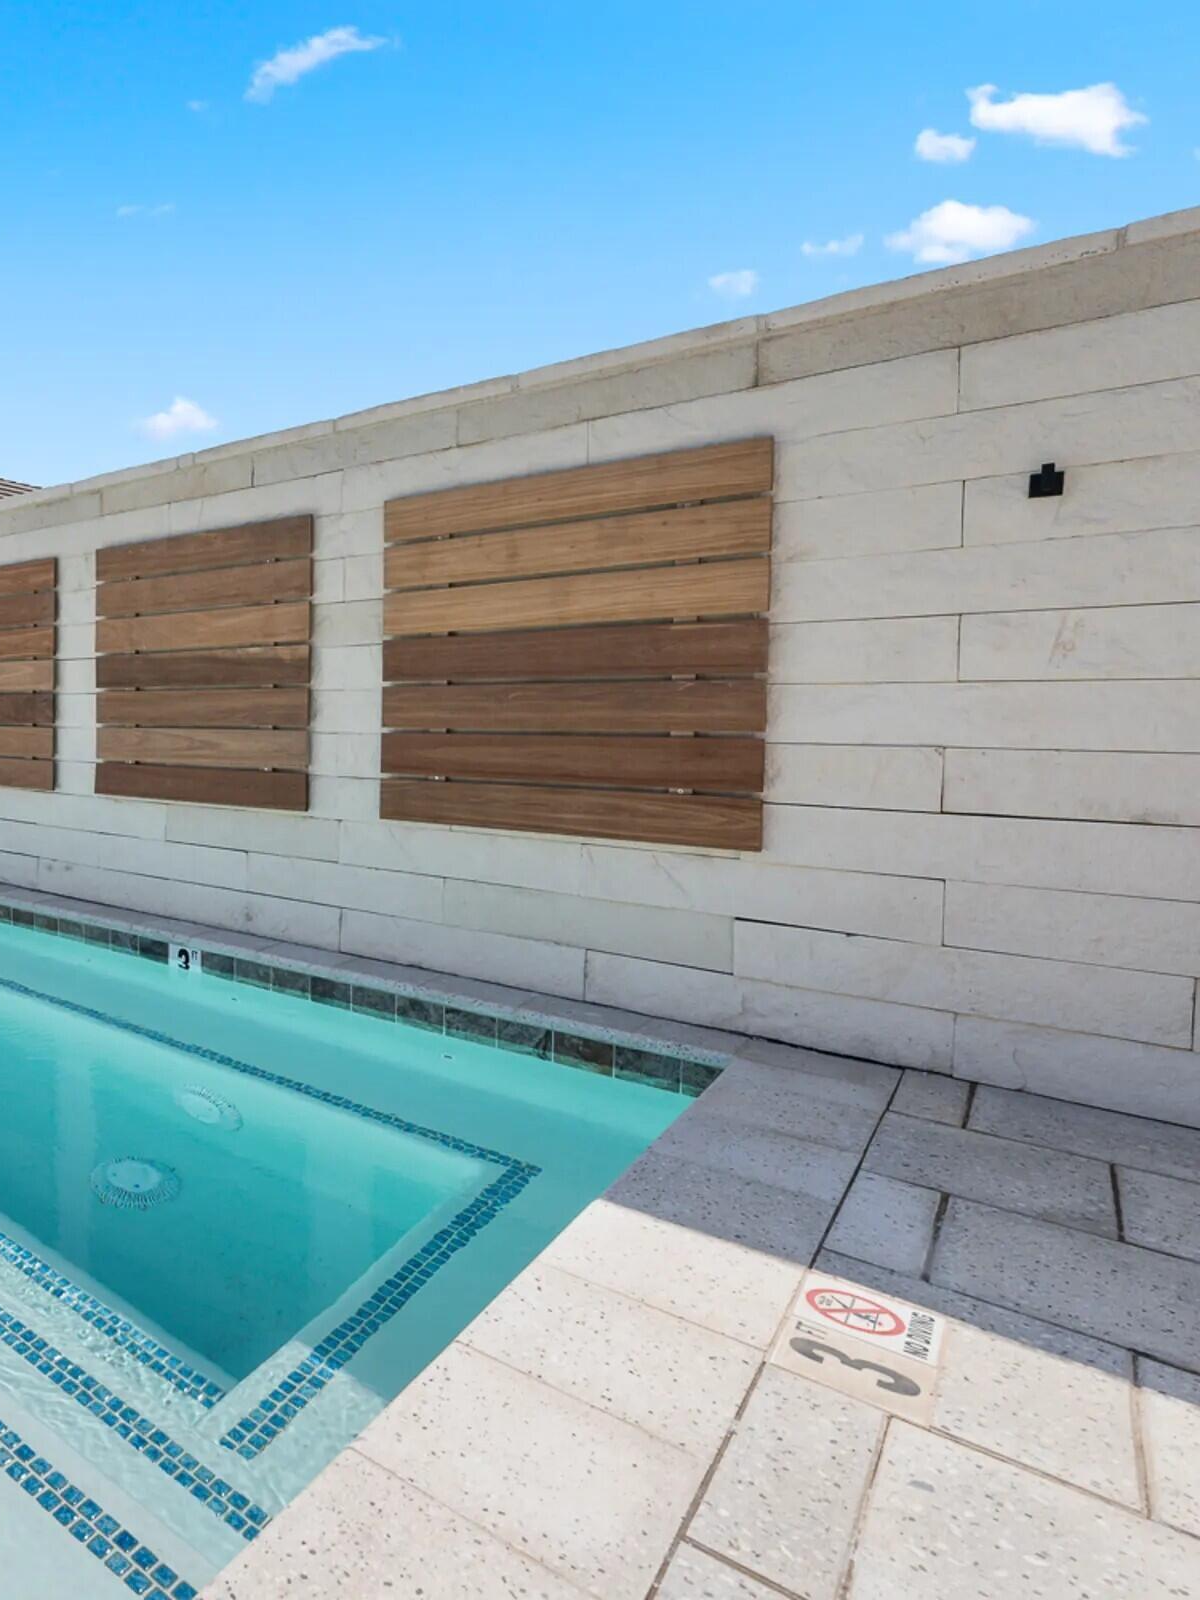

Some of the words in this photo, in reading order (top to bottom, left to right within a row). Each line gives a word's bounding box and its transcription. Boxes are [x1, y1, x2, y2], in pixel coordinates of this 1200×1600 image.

[177, 947, 191, 971] 3
[907, 1311, 936, 1345] DIVING
[903, 1340, 930, 1361] NO
[788, 1336, 922, 1397] 3
